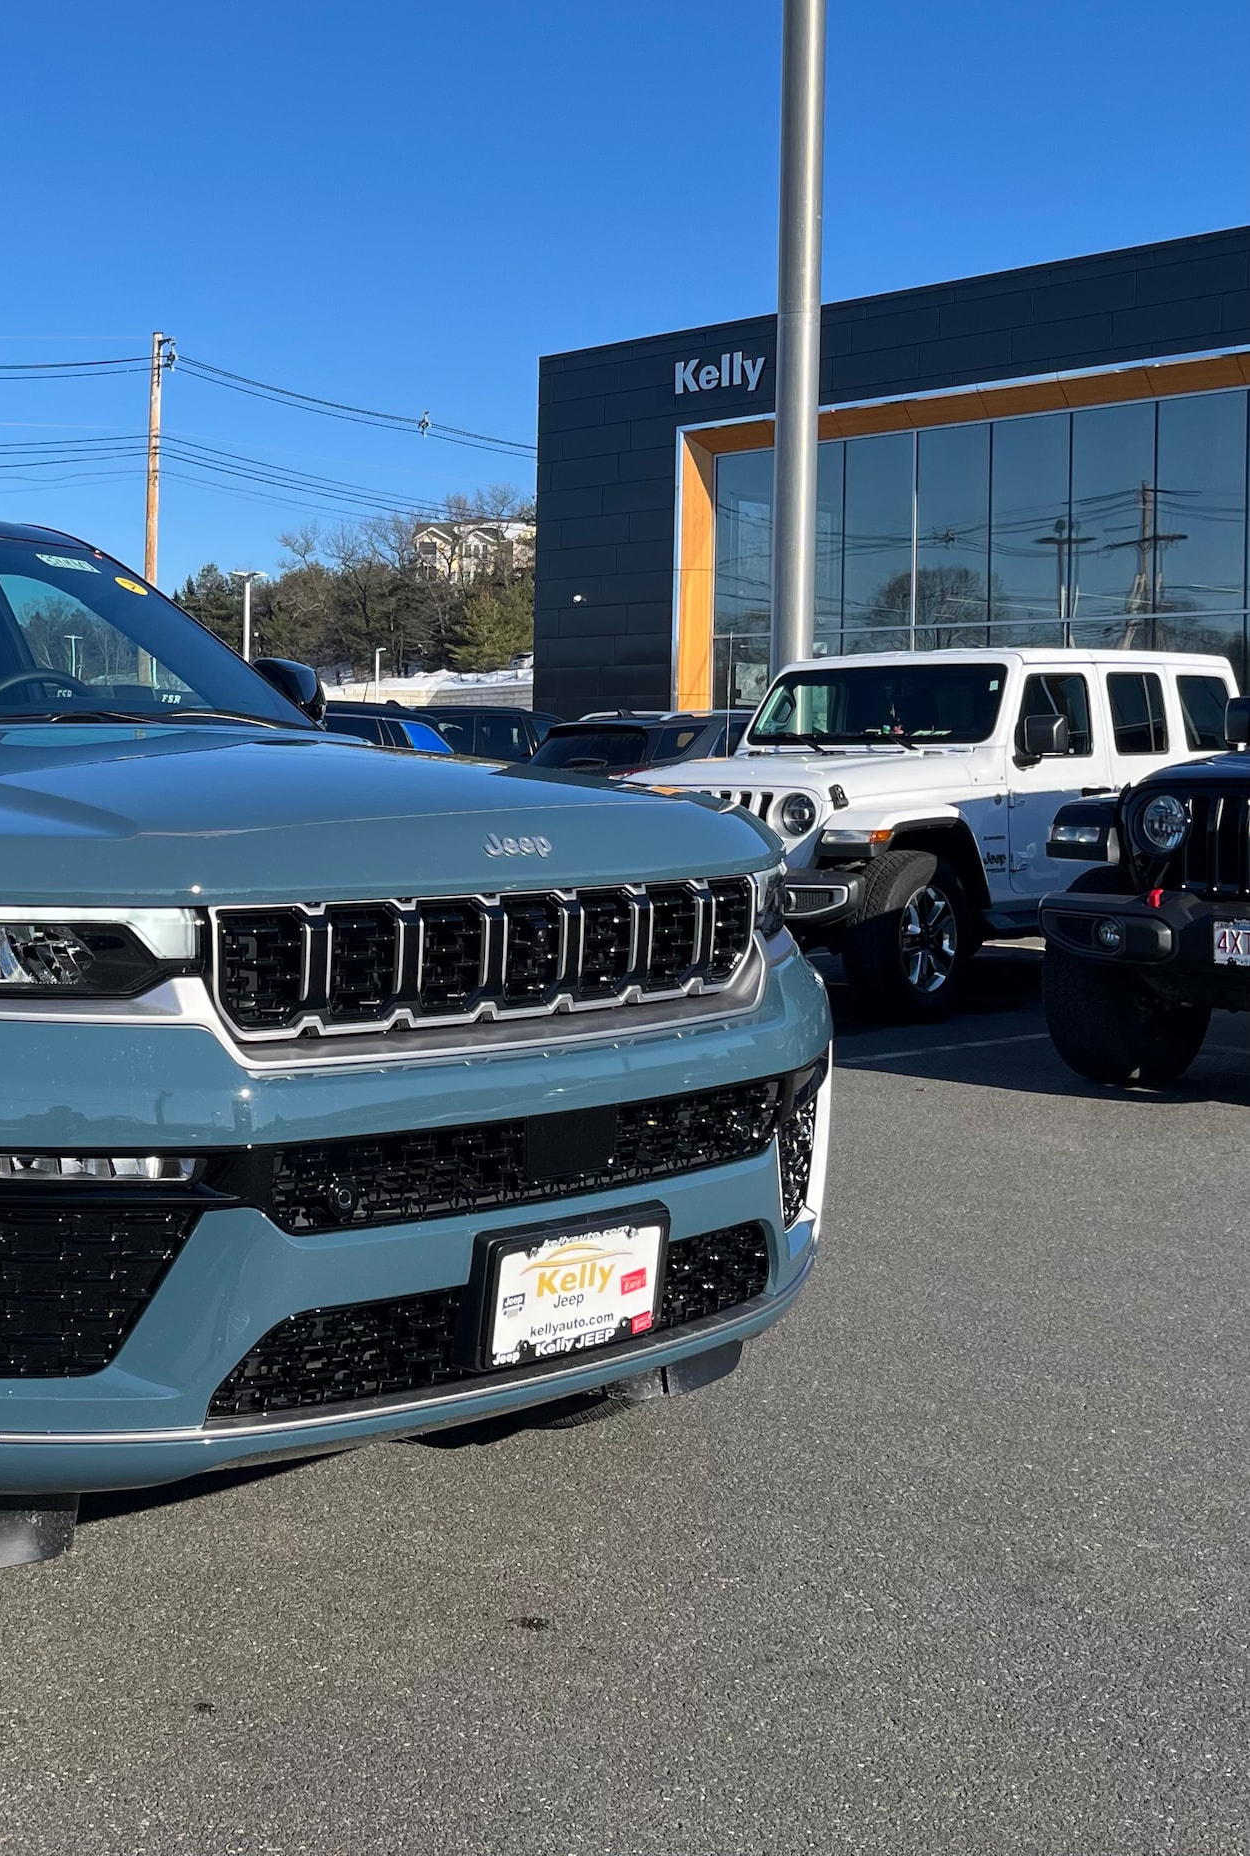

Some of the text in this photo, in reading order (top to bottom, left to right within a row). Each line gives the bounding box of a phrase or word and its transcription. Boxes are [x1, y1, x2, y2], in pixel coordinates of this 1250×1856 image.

[674, 350, 767, 395] Kelly
[161, 694, 181, 704] FSR
[482, 832, 553, 858] Jeep
[983, 851, 1006, 866] Jeep
[542, 1225, 630, 1248] kellyauto.com
[536, 1262, 616, 1298] Kelly
[504, 1295, 524, 1308] Jeep
[553, 1293, 585, 1309] Jeep
[530, 1312, 615, 1337] kellyauto.com
[534, 1327, 616, 1357] Kelly JEEP
[492, 1351, 521, 1366] Jeep
